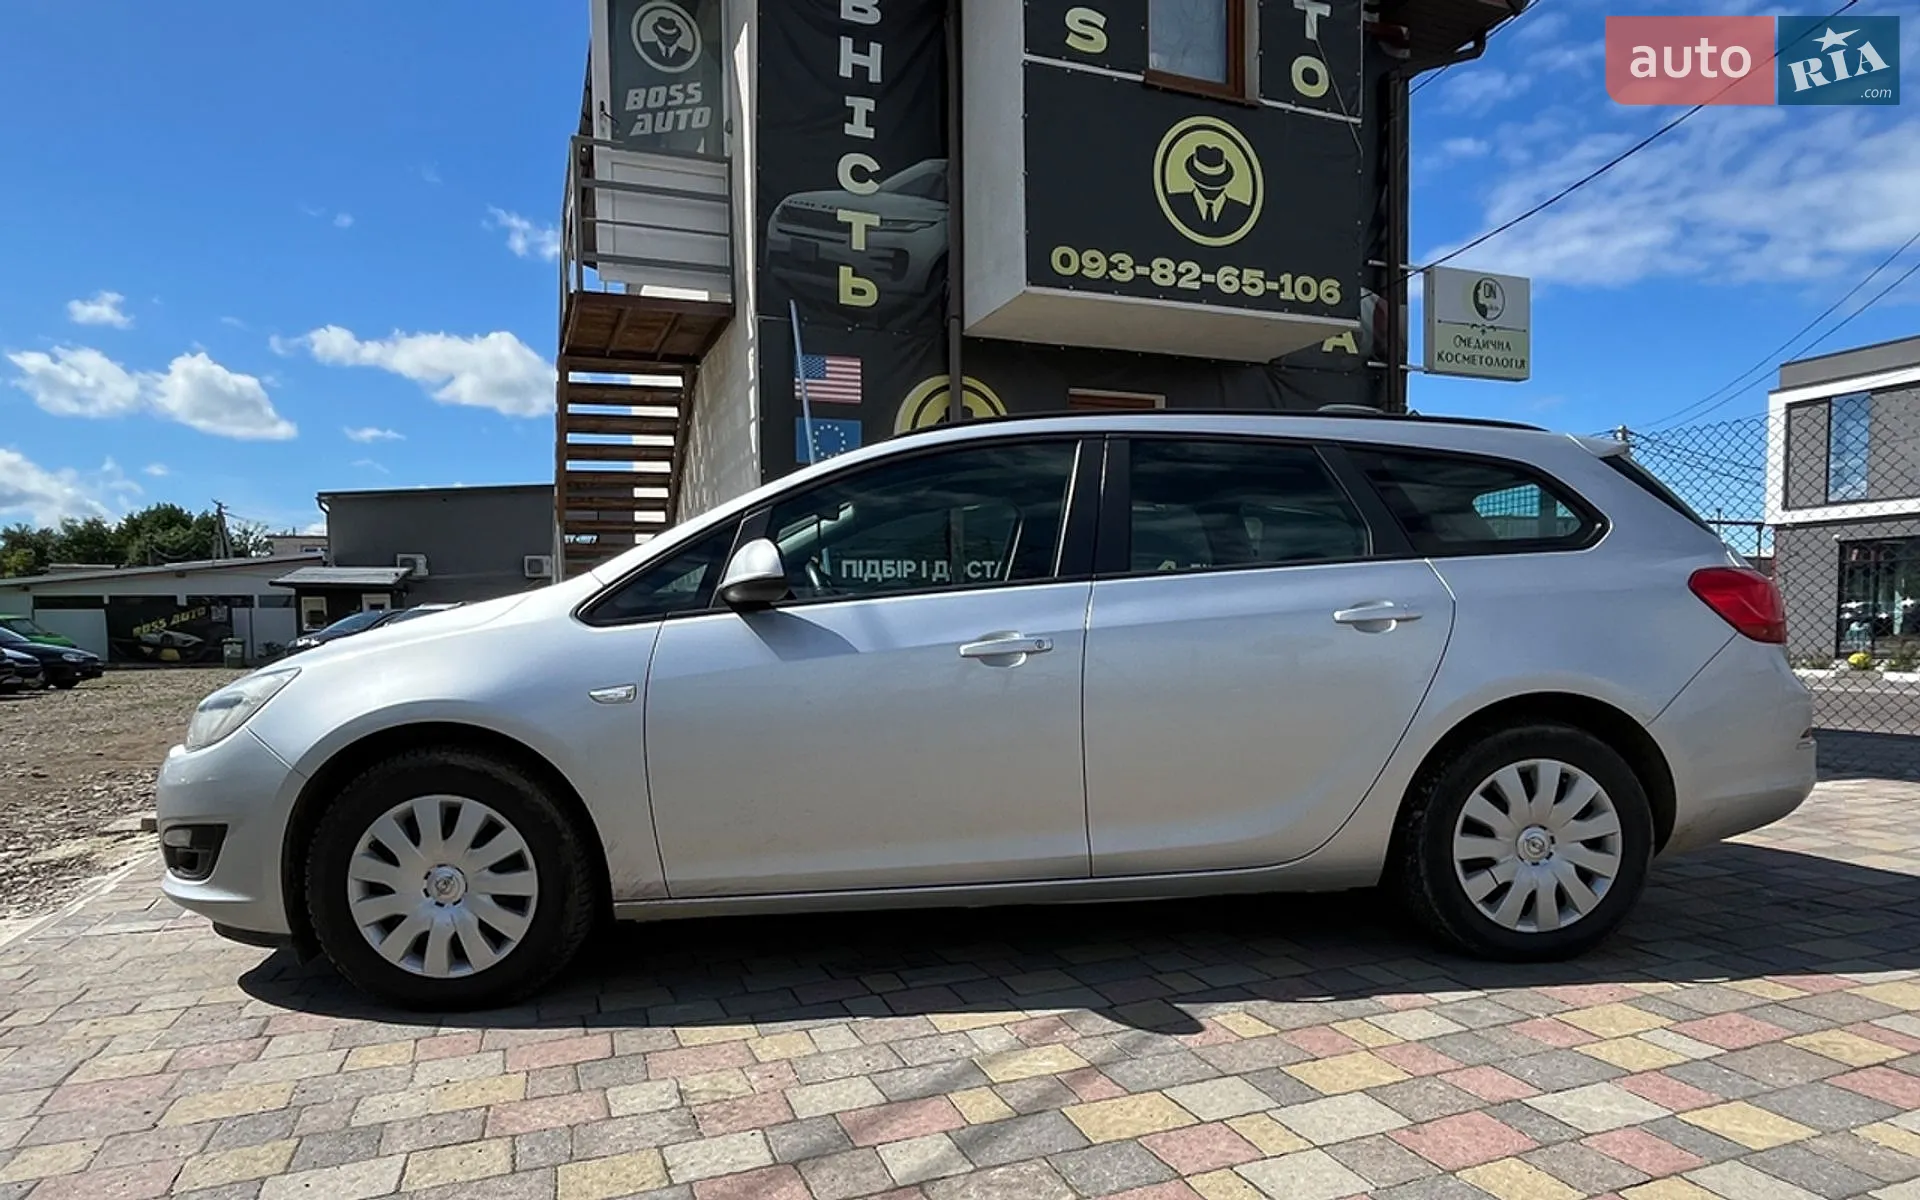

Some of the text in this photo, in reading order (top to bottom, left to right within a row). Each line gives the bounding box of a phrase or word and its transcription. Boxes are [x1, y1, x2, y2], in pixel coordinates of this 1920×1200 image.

[625, 82, 703, 111] BOSS
[629, 106, 711, 137] AUTO
[1050, 246, 1342, 306] 093-82-65-106
[1452, 334, 1512, 351] МЕДИЧНА
[1436, 350, 1526, 370] КОСМЕТОЛОГІЯ
[841, 560, 916, 582] ПІДБІР
[169, 606, 206, 626] AUTO
